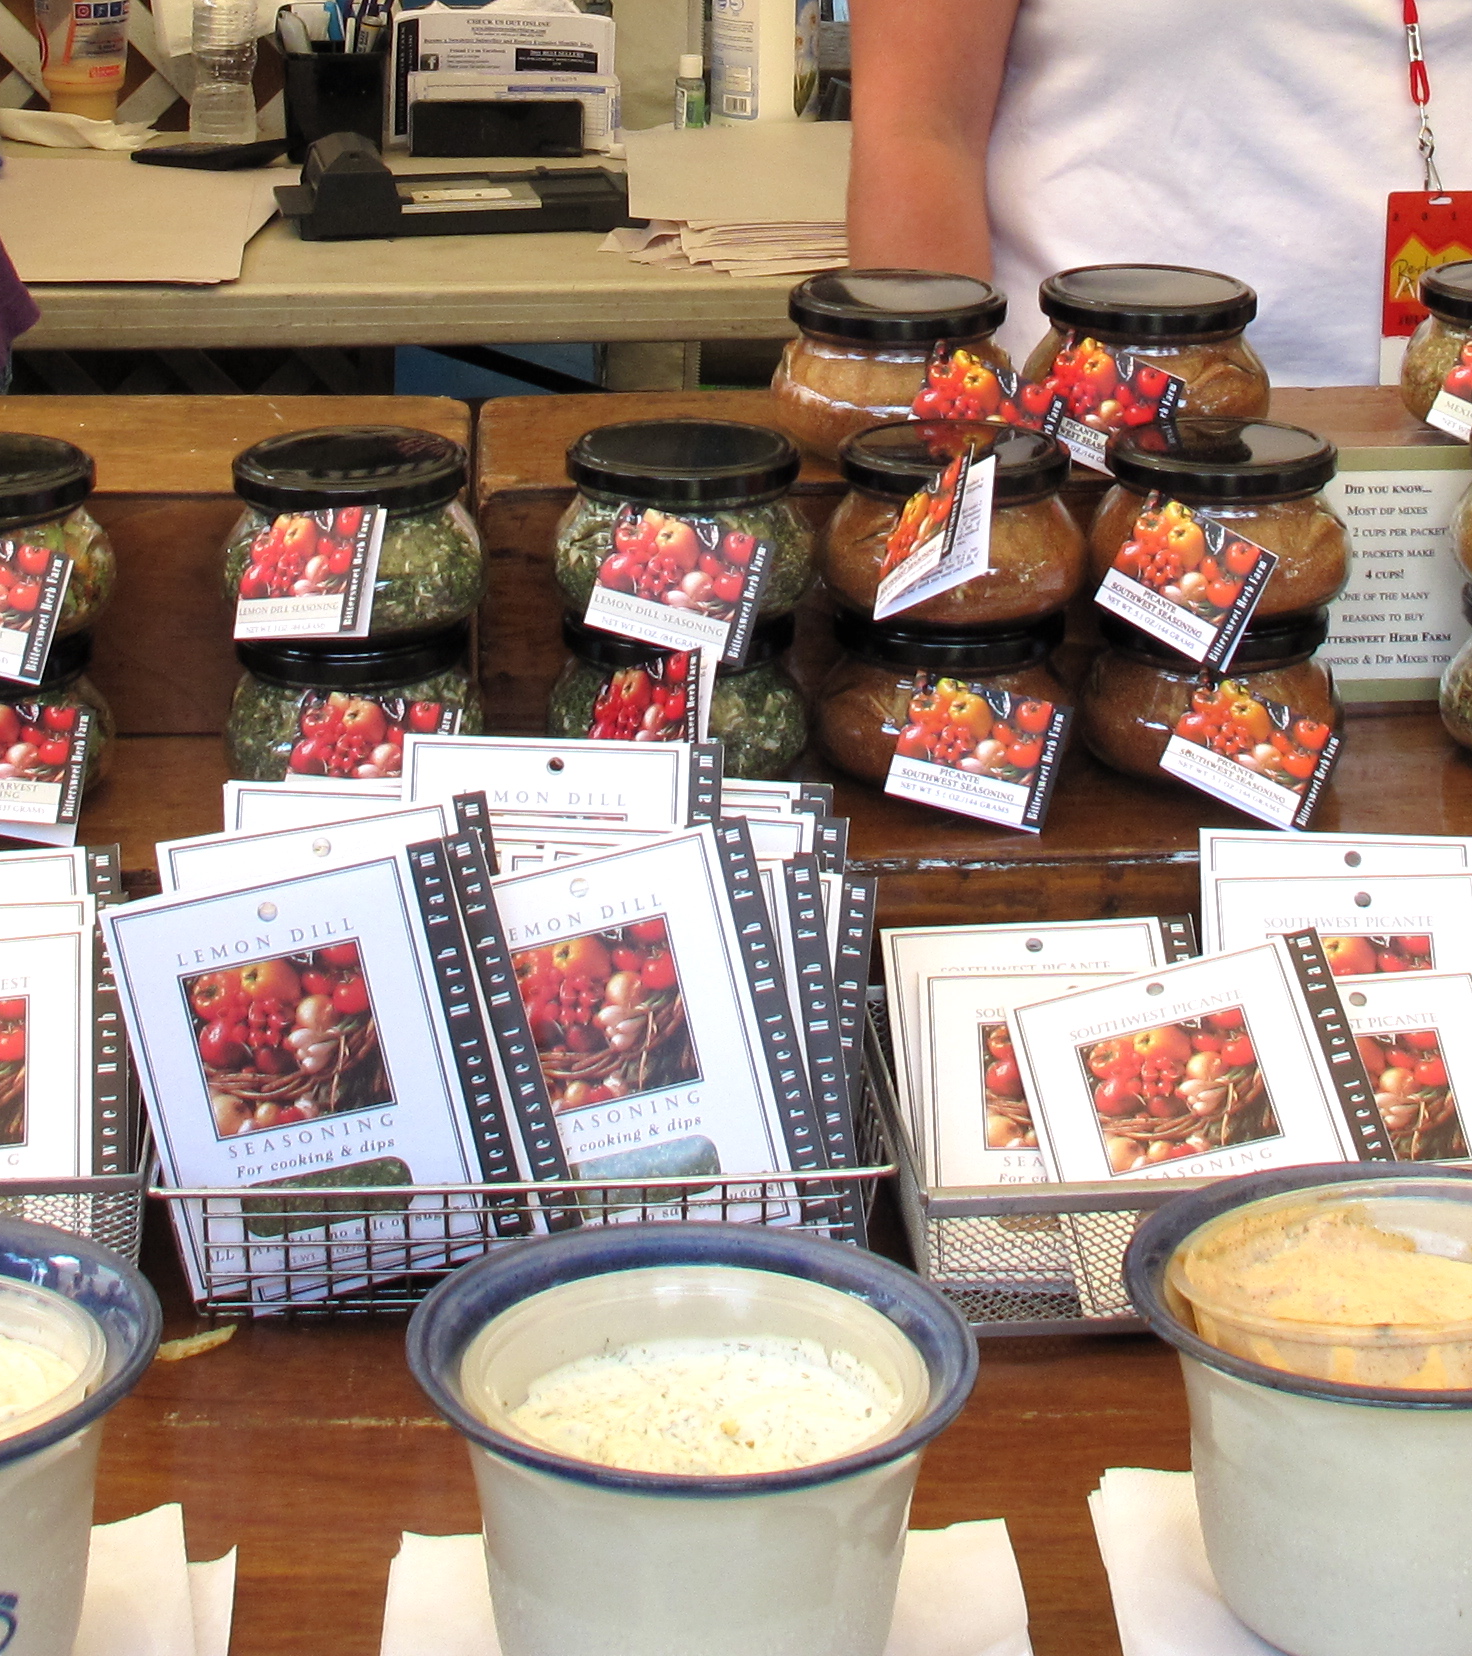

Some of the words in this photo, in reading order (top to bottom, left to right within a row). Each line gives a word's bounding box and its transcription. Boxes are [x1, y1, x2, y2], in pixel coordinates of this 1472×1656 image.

[1345, 484, 1365, 494] DID
[1368, 485, 1388, 494] YOU
[1347, 506, 1376, 516] MOST
[1380, 507, 1395, 515] DIP
[1398, 506, 1428, 514] MIXES
[1353, 528, 1359, 537] 2
[1362, 529, 1386, 537] CUPS
[1390, 528, 1407, 536] PER
[751, 547, 767, 576] Farm
[1362, 549, 1404, 558] PACKETS
[1407, 549, 1435, 557] MAKE
[745, 575, 760, 600] Herb
[1365, 570, 1372, 579] 4
[1338, 592, 1360, 601] ONE
[1363, 592, 1377, 600] OF
[1380, 592, 1398, 600] THE
[1401, 592, 1430, 600] MANY
[595, 593, 632, 614] LEMON
[635, 605, 660, 620] DILL
[663, 612, 724, 638] SEASONING
[727, 598, 752, 658] Bittersweet
[1342, 613, 1385, 622] REASONS
[1388, 613, 1401, 621] TO
[1405, 613, 1424, 621] BUY
[1327, 635, 1385, 644] TTERSWEET
[1389, 632, 1418, 642] HERB
[1422, 632, 1451, 642] FARM
[1362, 655, 1371, 664] &
[1376, 654, 1394, 664] DIP
[1396, 653, 1428, 664] MIXES
[420, 851, 449, 925] Farm
[176, 933, 272, 968] LEMON
[291, 916, 356, 944] DILL
[437, 947, 470, 1017] Herb
[1070, 1007, 1167, 1042] SOUTHWEST
[1172, 989, 1243, 1016] PICANTE
[228, 1111, 396, 1159] SEASONING
[460, 1038, 521, 1227] Bitersweet
[236, 1160, 265, 1179] For
[270, 1148, 335, 1176] cooking
[340, 1143, 353, 1158] &
[359, 1135, 396, 1156] dips
